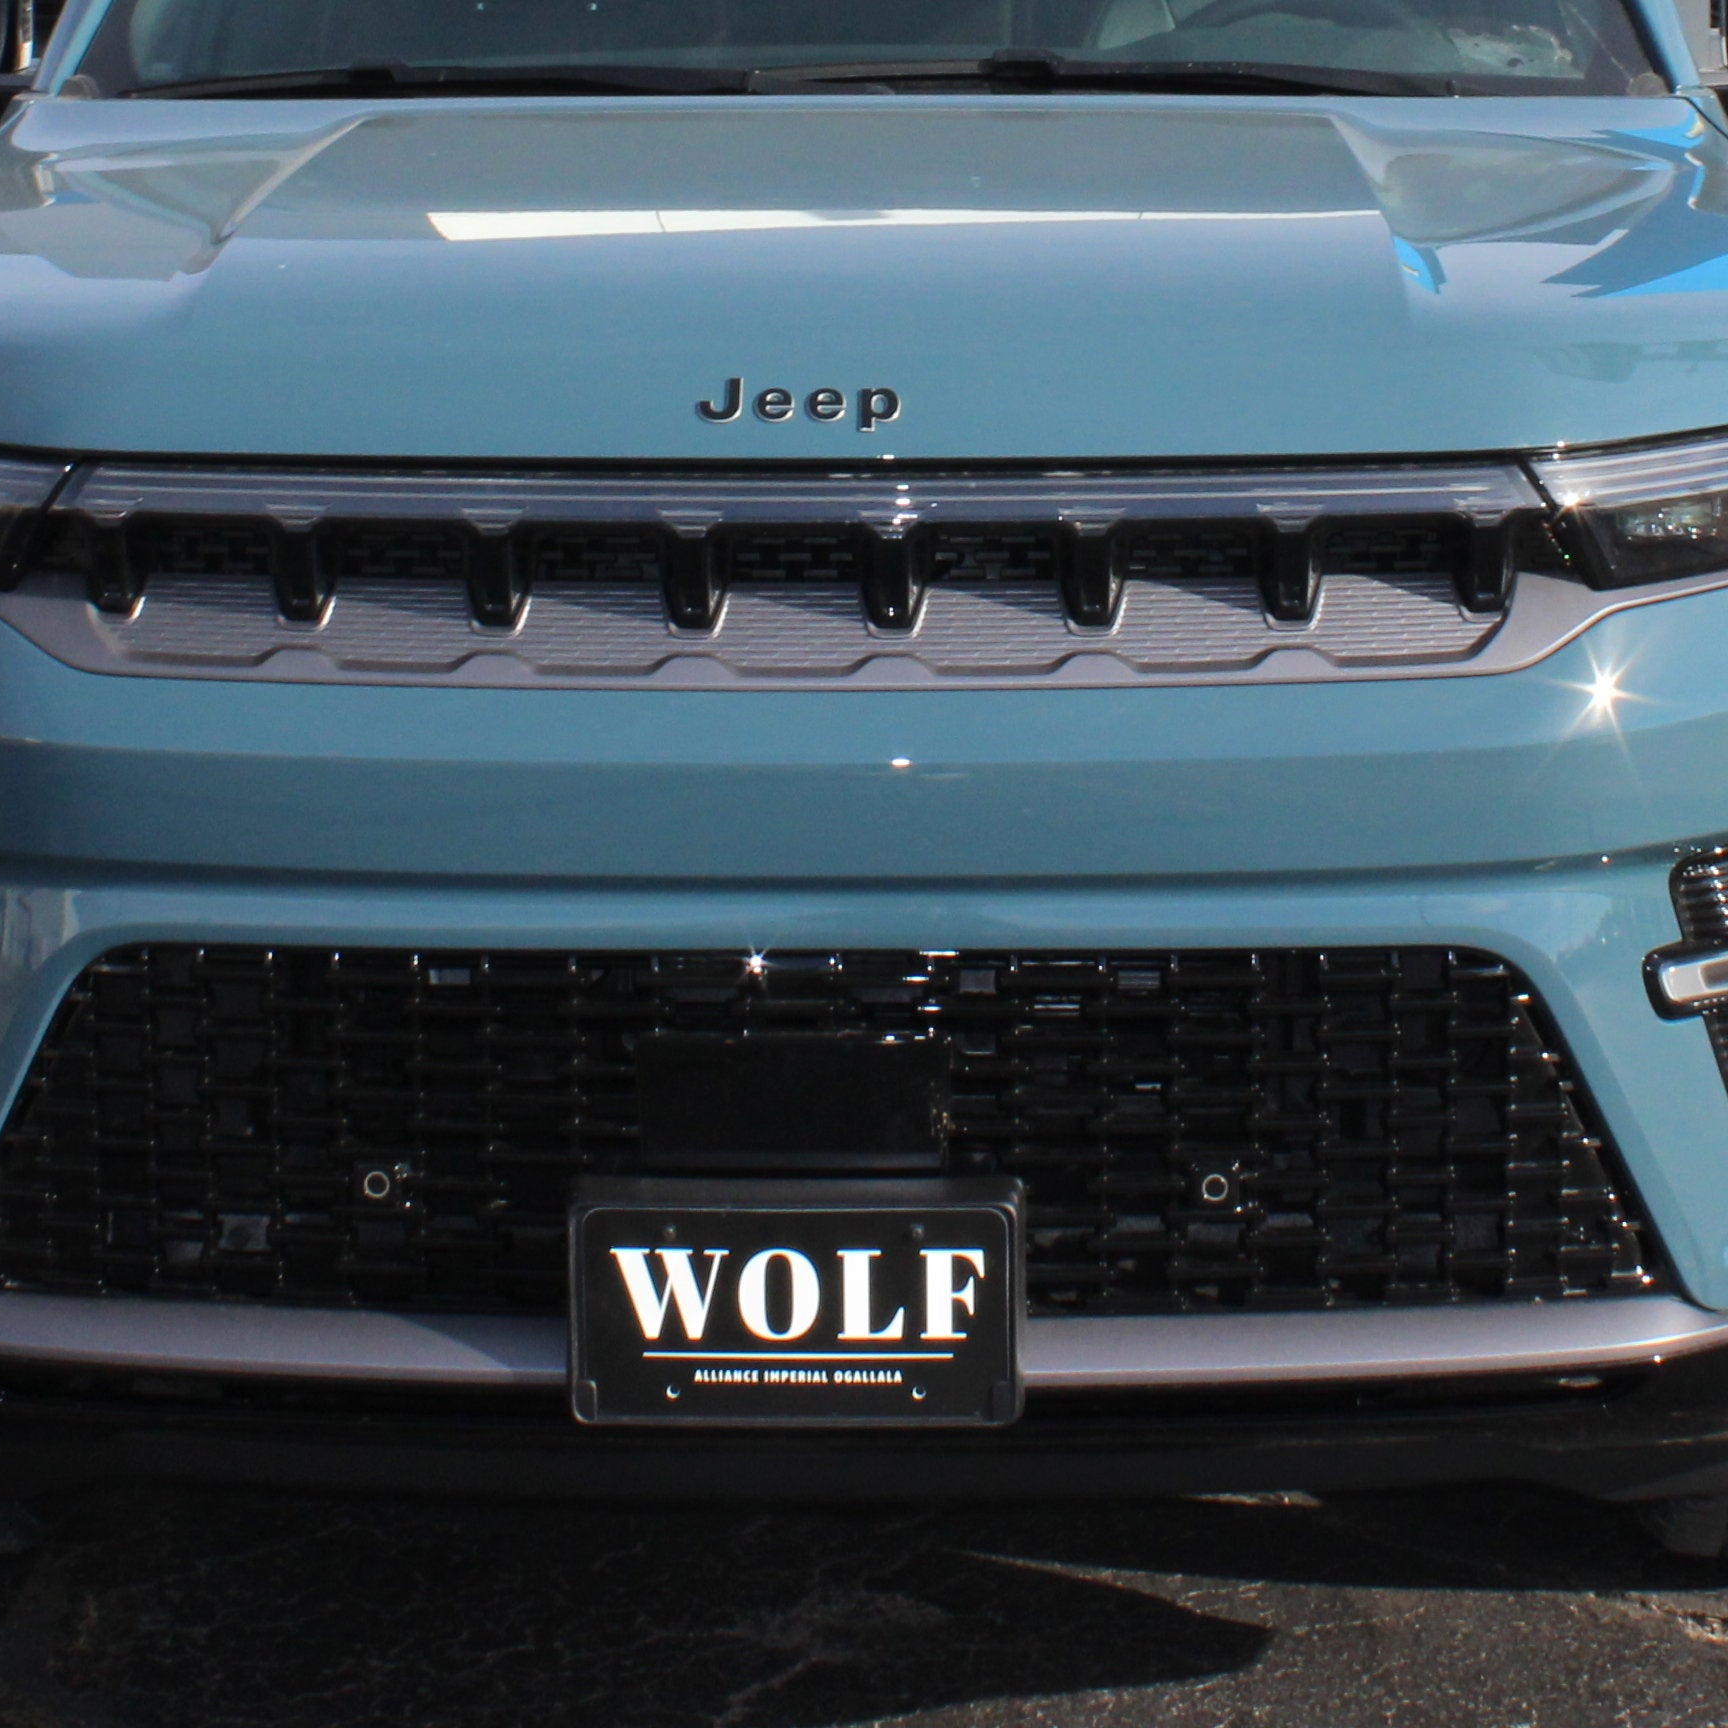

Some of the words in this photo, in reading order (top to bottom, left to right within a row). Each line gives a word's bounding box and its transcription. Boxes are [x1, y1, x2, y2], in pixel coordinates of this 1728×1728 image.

[696, 376, 901, 432] Jeep
[609, 1247, 985, 1340] WOLF
[694, 1369, 759, 1384] ALLIANCE
[764, 1369, 828, 1384] IMPERIAL
[834, 1370, 903, 1384] OGALLALA
